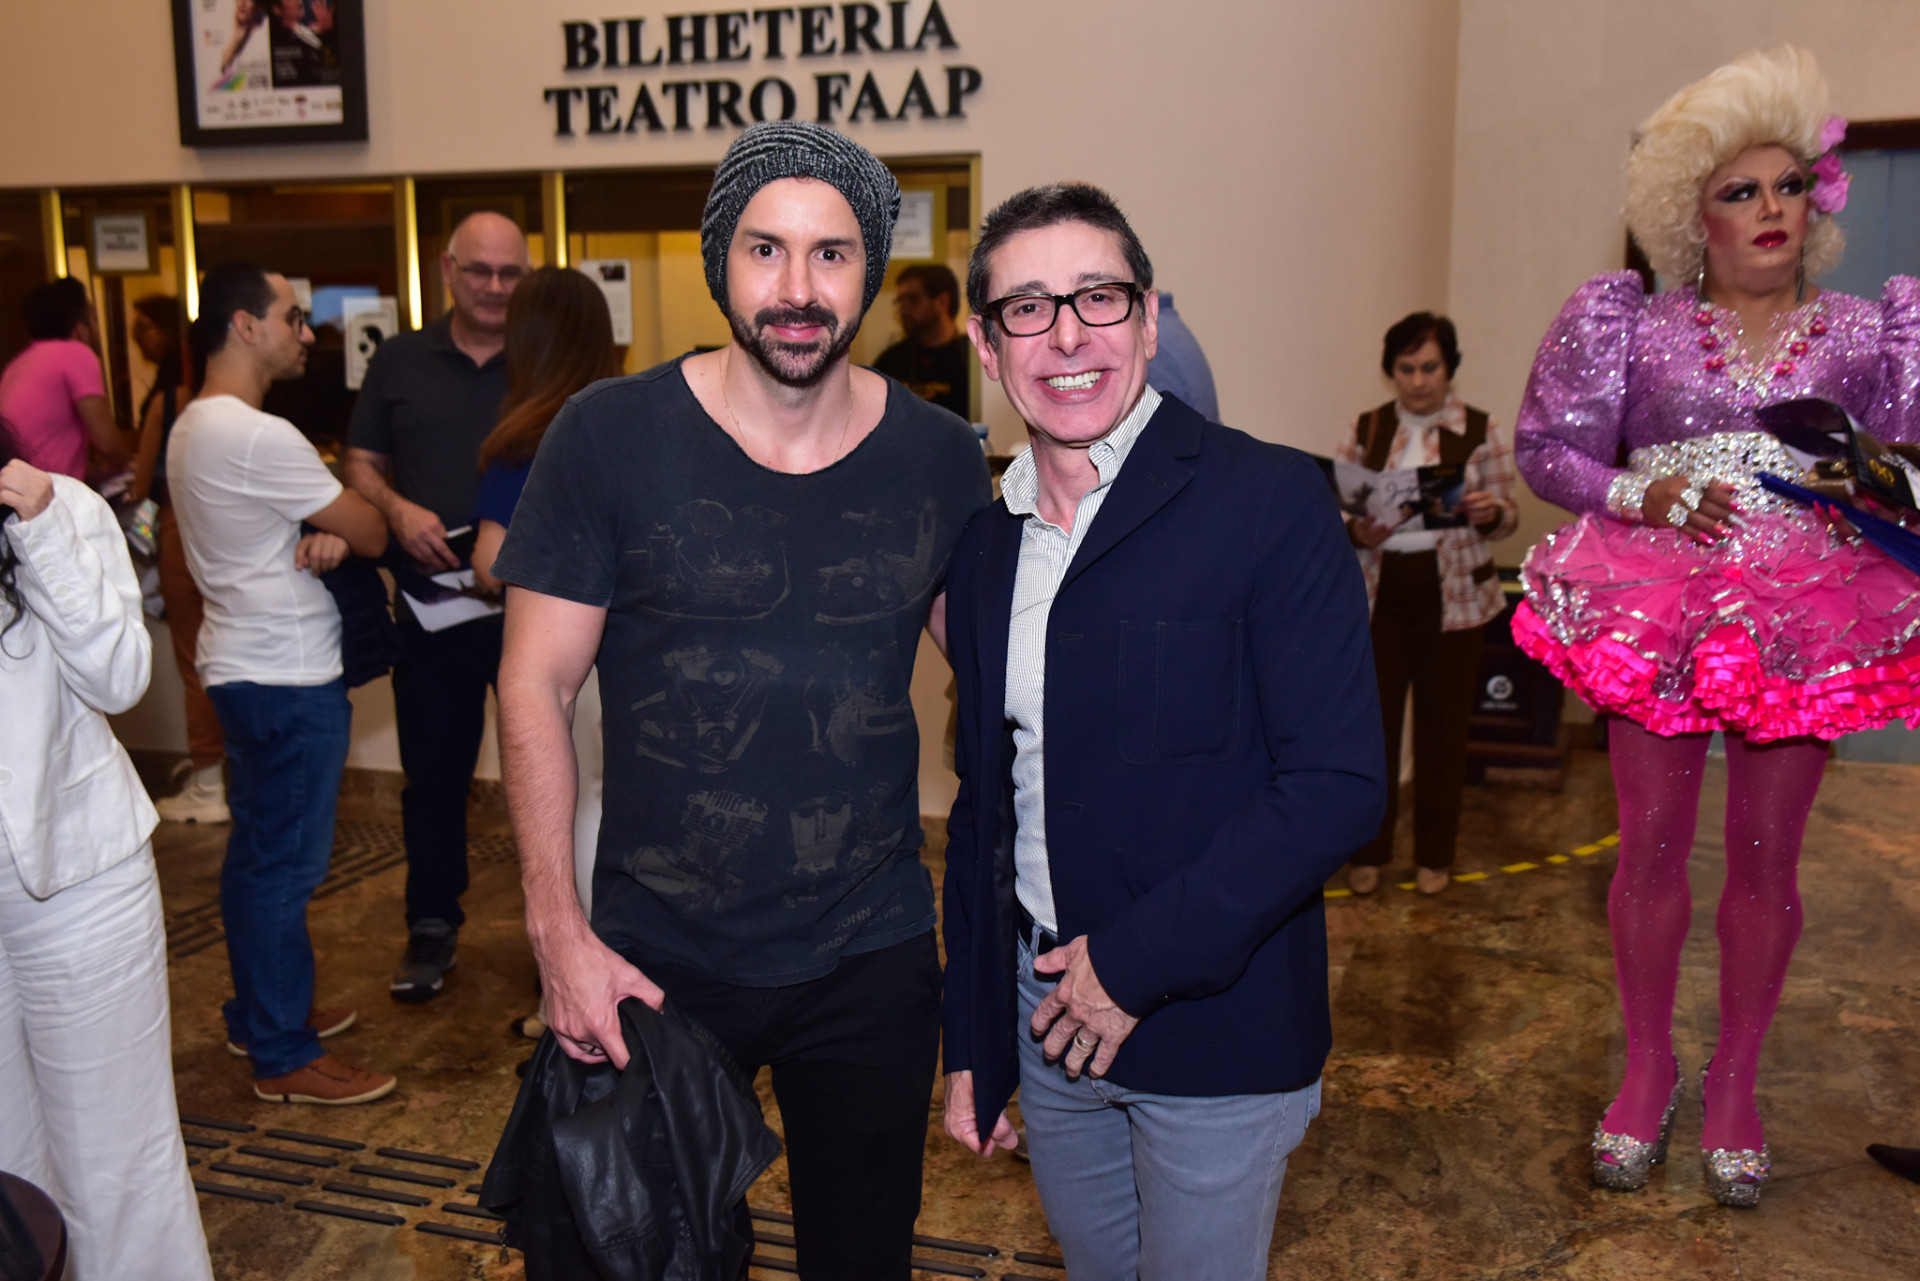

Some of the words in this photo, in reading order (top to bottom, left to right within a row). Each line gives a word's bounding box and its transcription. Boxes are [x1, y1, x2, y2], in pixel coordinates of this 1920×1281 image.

[562, 0, 959, 72] BILHETERIA
[543, 76, 797, 136] TEATRO
[813, 65, 983, 124] FAAP
[833, 906, 871, 932] JOHN
